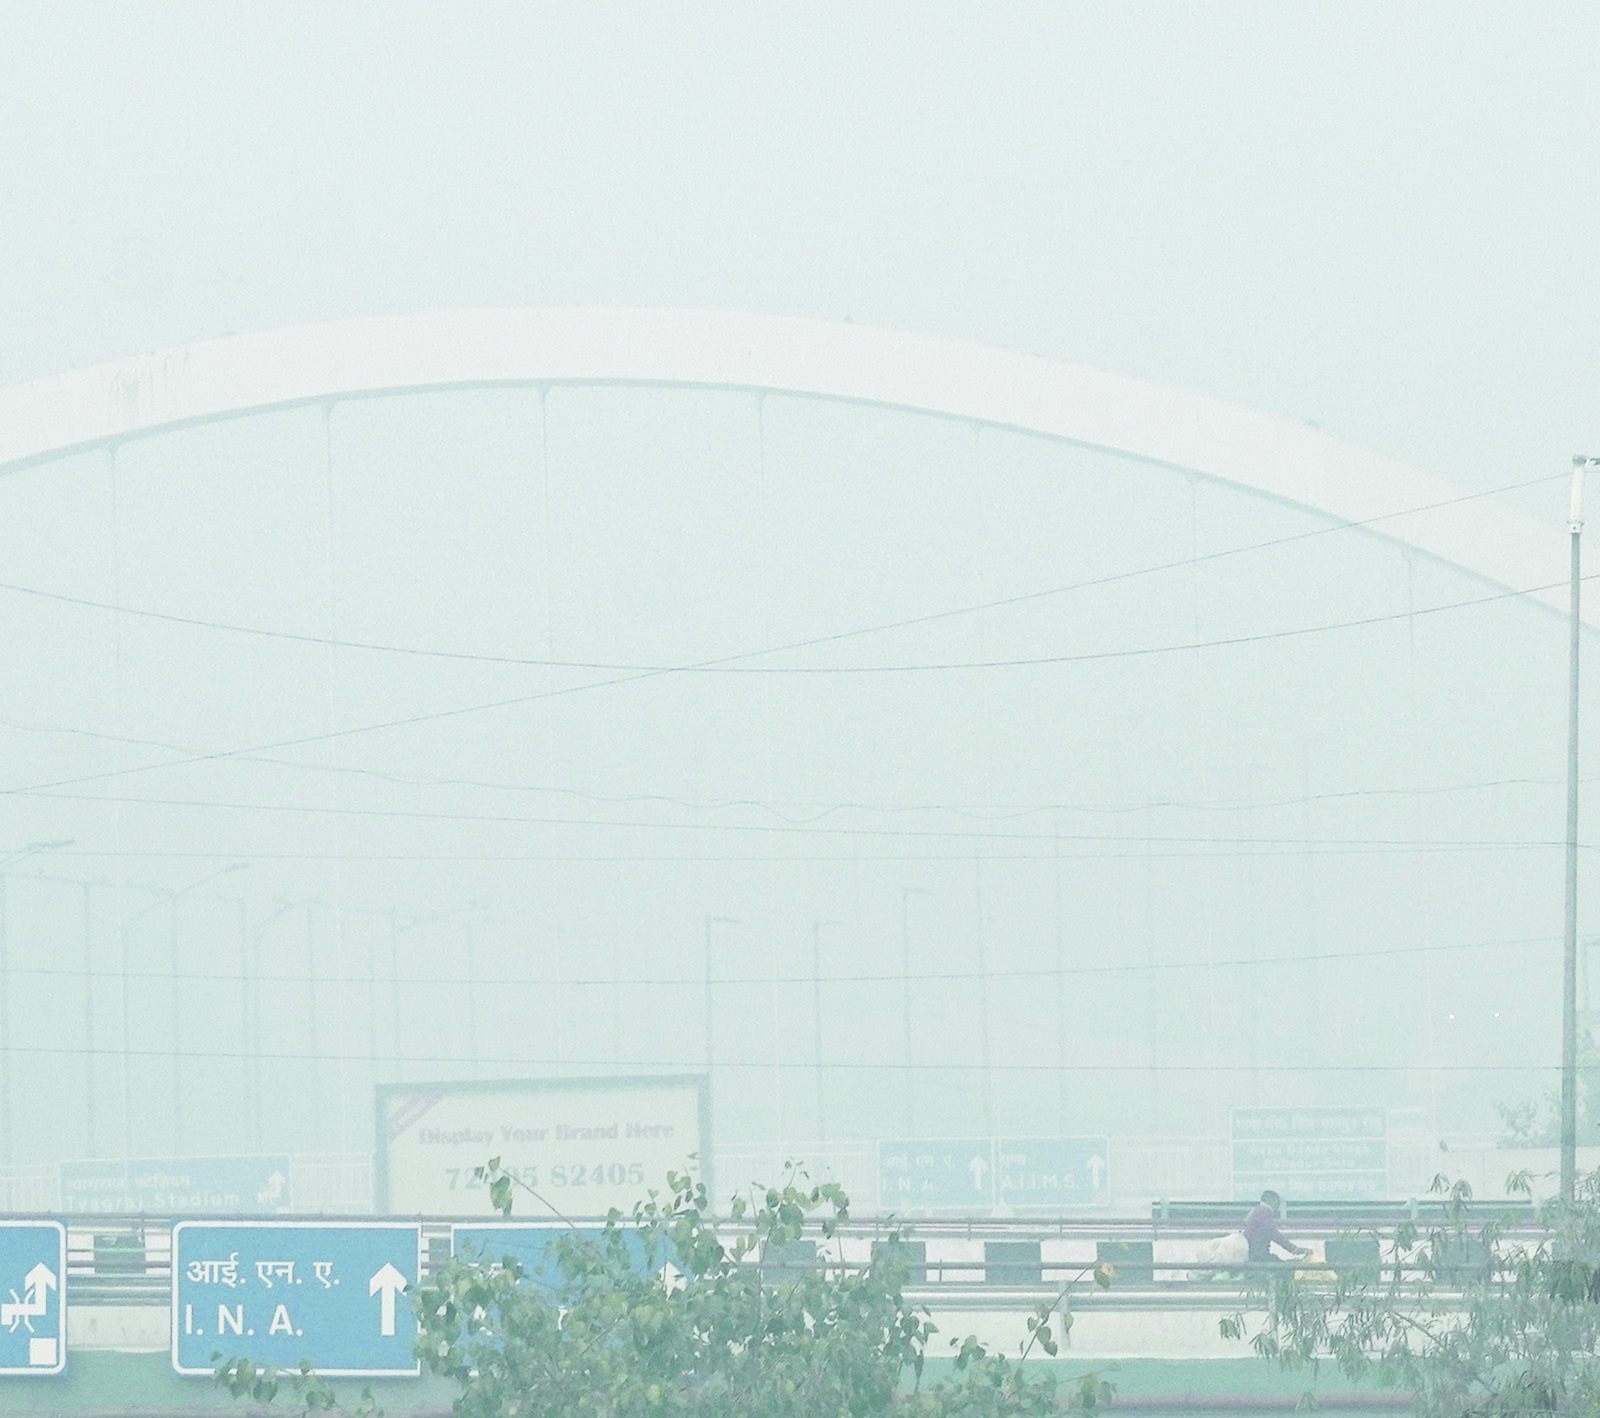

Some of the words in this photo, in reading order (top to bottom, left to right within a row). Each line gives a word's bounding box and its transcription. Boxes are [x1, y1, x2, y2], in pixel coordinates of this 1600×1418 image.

[500, 1125, 548, 1142] Your
[556, 1123, 619, 1140] Brand
[625, 1122, 674, 1138] Here
[550, 1163, 644, 1187] 82405
[154, 1190, 240, 1207] Stadium
[186, 1252, 247, 1288] आई.
[255, 1261, 302, 1288] एन.
[313, 1261, 340, 1288] ए.
